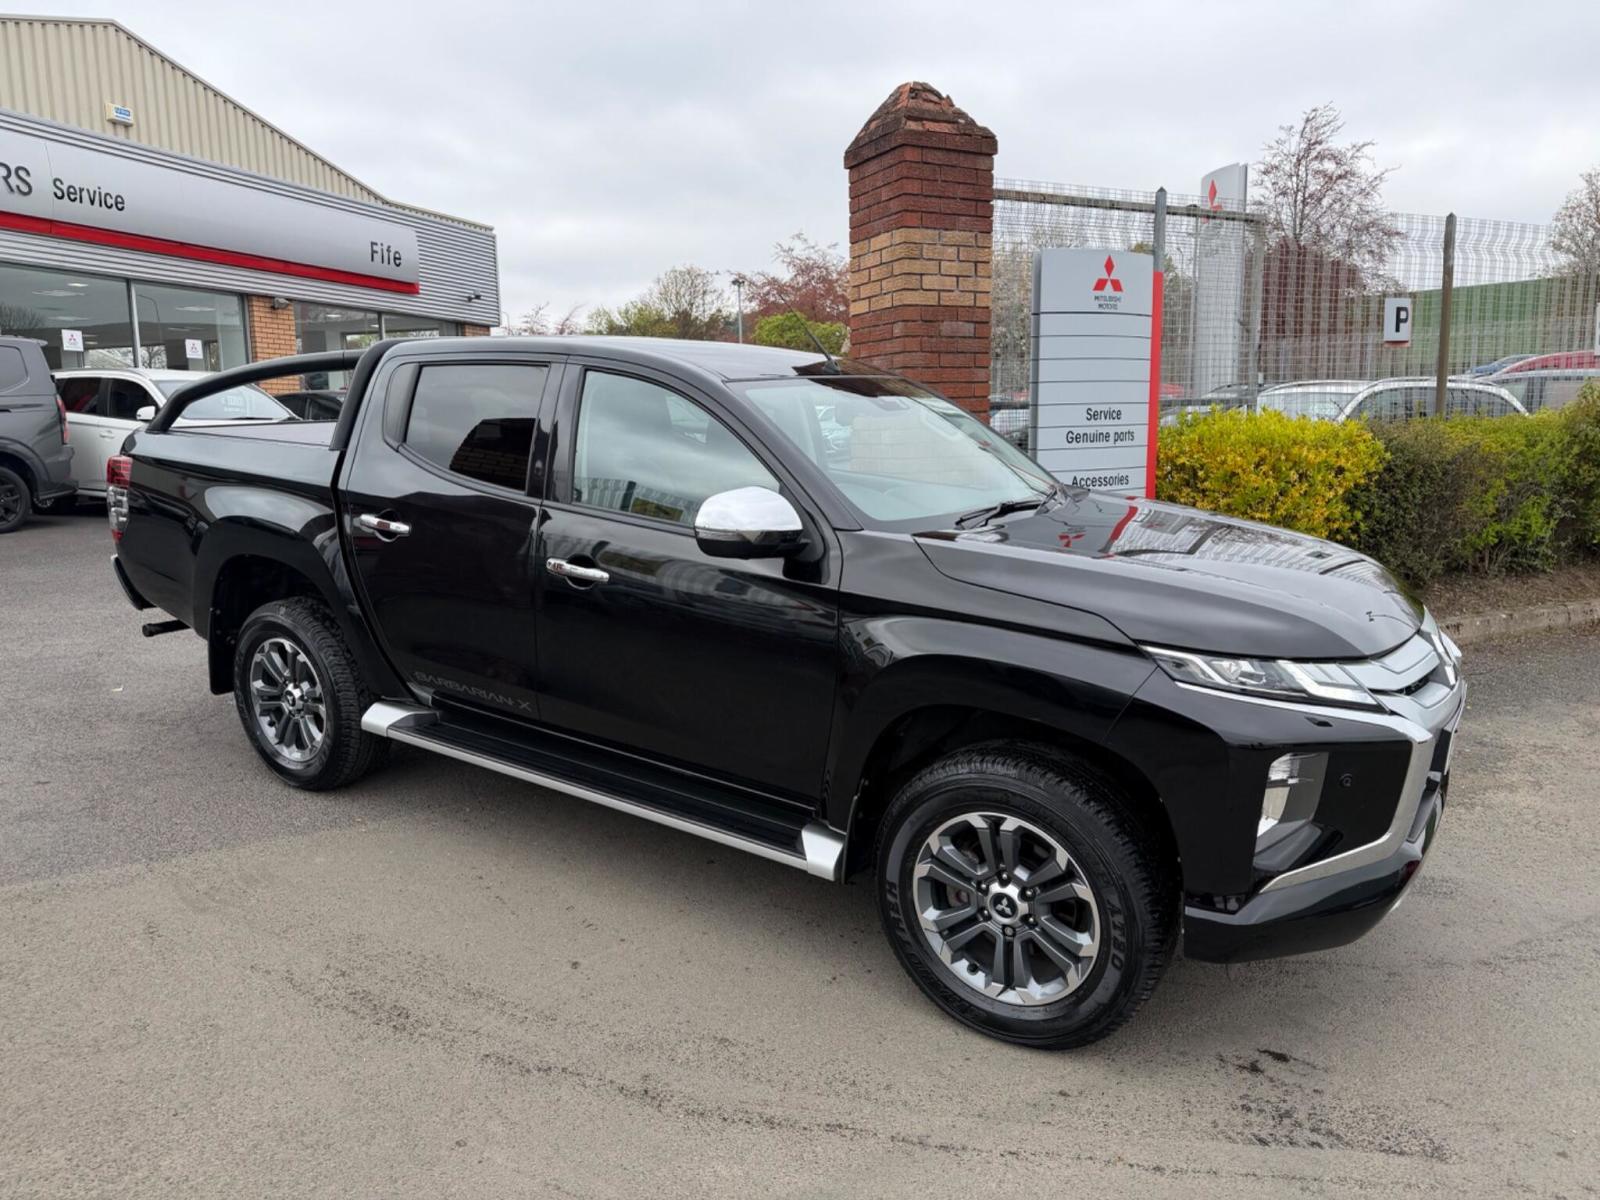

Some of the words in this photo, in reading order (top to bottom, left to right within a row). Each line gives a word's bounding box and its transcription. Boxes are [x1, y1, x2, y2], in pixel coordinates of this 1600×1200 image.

[52, 177, 125, 212] Service
[370, 241, 402, 267] Fife
[1395, 306, 1409, 333] P
[1086, 407, 1122, 421] Service
[1066, 430, 1111, 444] Genuine
[1113, 429, 1135, 444] parts
[1071, 473, 1129, 488] Accessories
[413, 671, 514, 706] BARBARIAN
[518, 698, 532, 712] X
